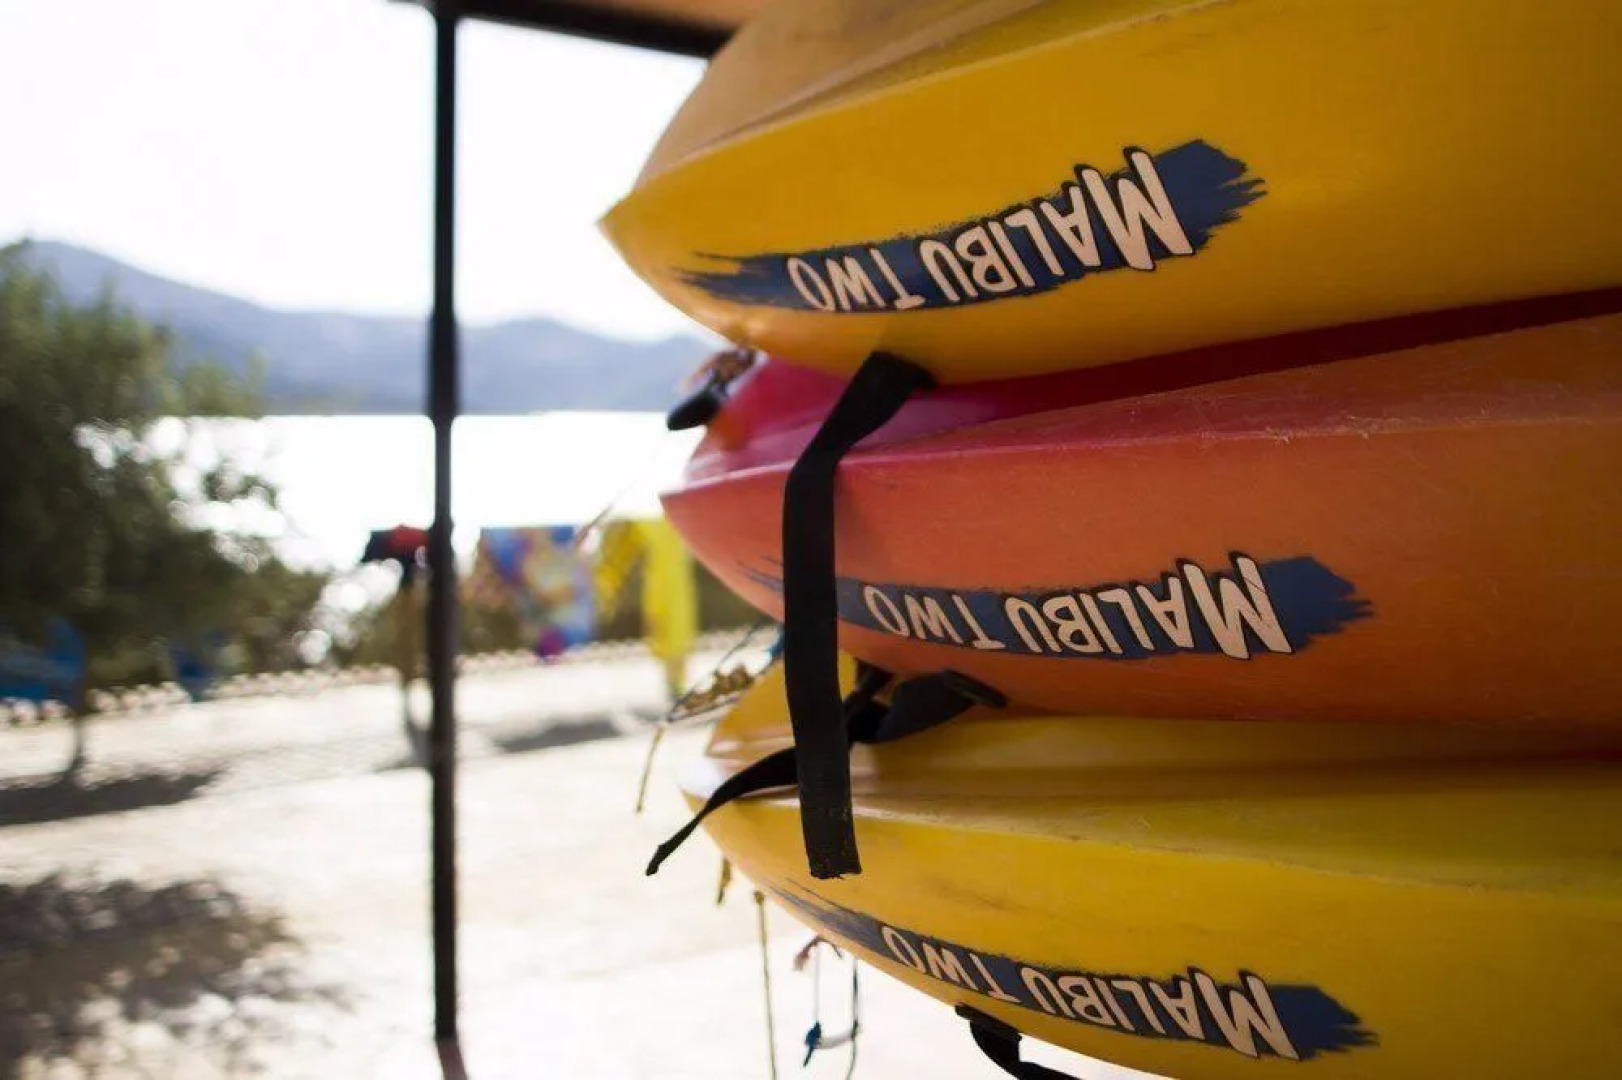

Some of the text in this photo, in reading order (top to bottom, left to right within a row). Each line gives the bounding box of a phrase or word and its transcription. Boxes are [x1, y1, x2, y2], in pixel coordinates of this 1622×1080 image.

[786, 148, 1194, 311] MALIBU TWO
[862, 554, 1293, 660] MALIBU TWO
[881, 925, 1300, 1060] MALIBU TWO
